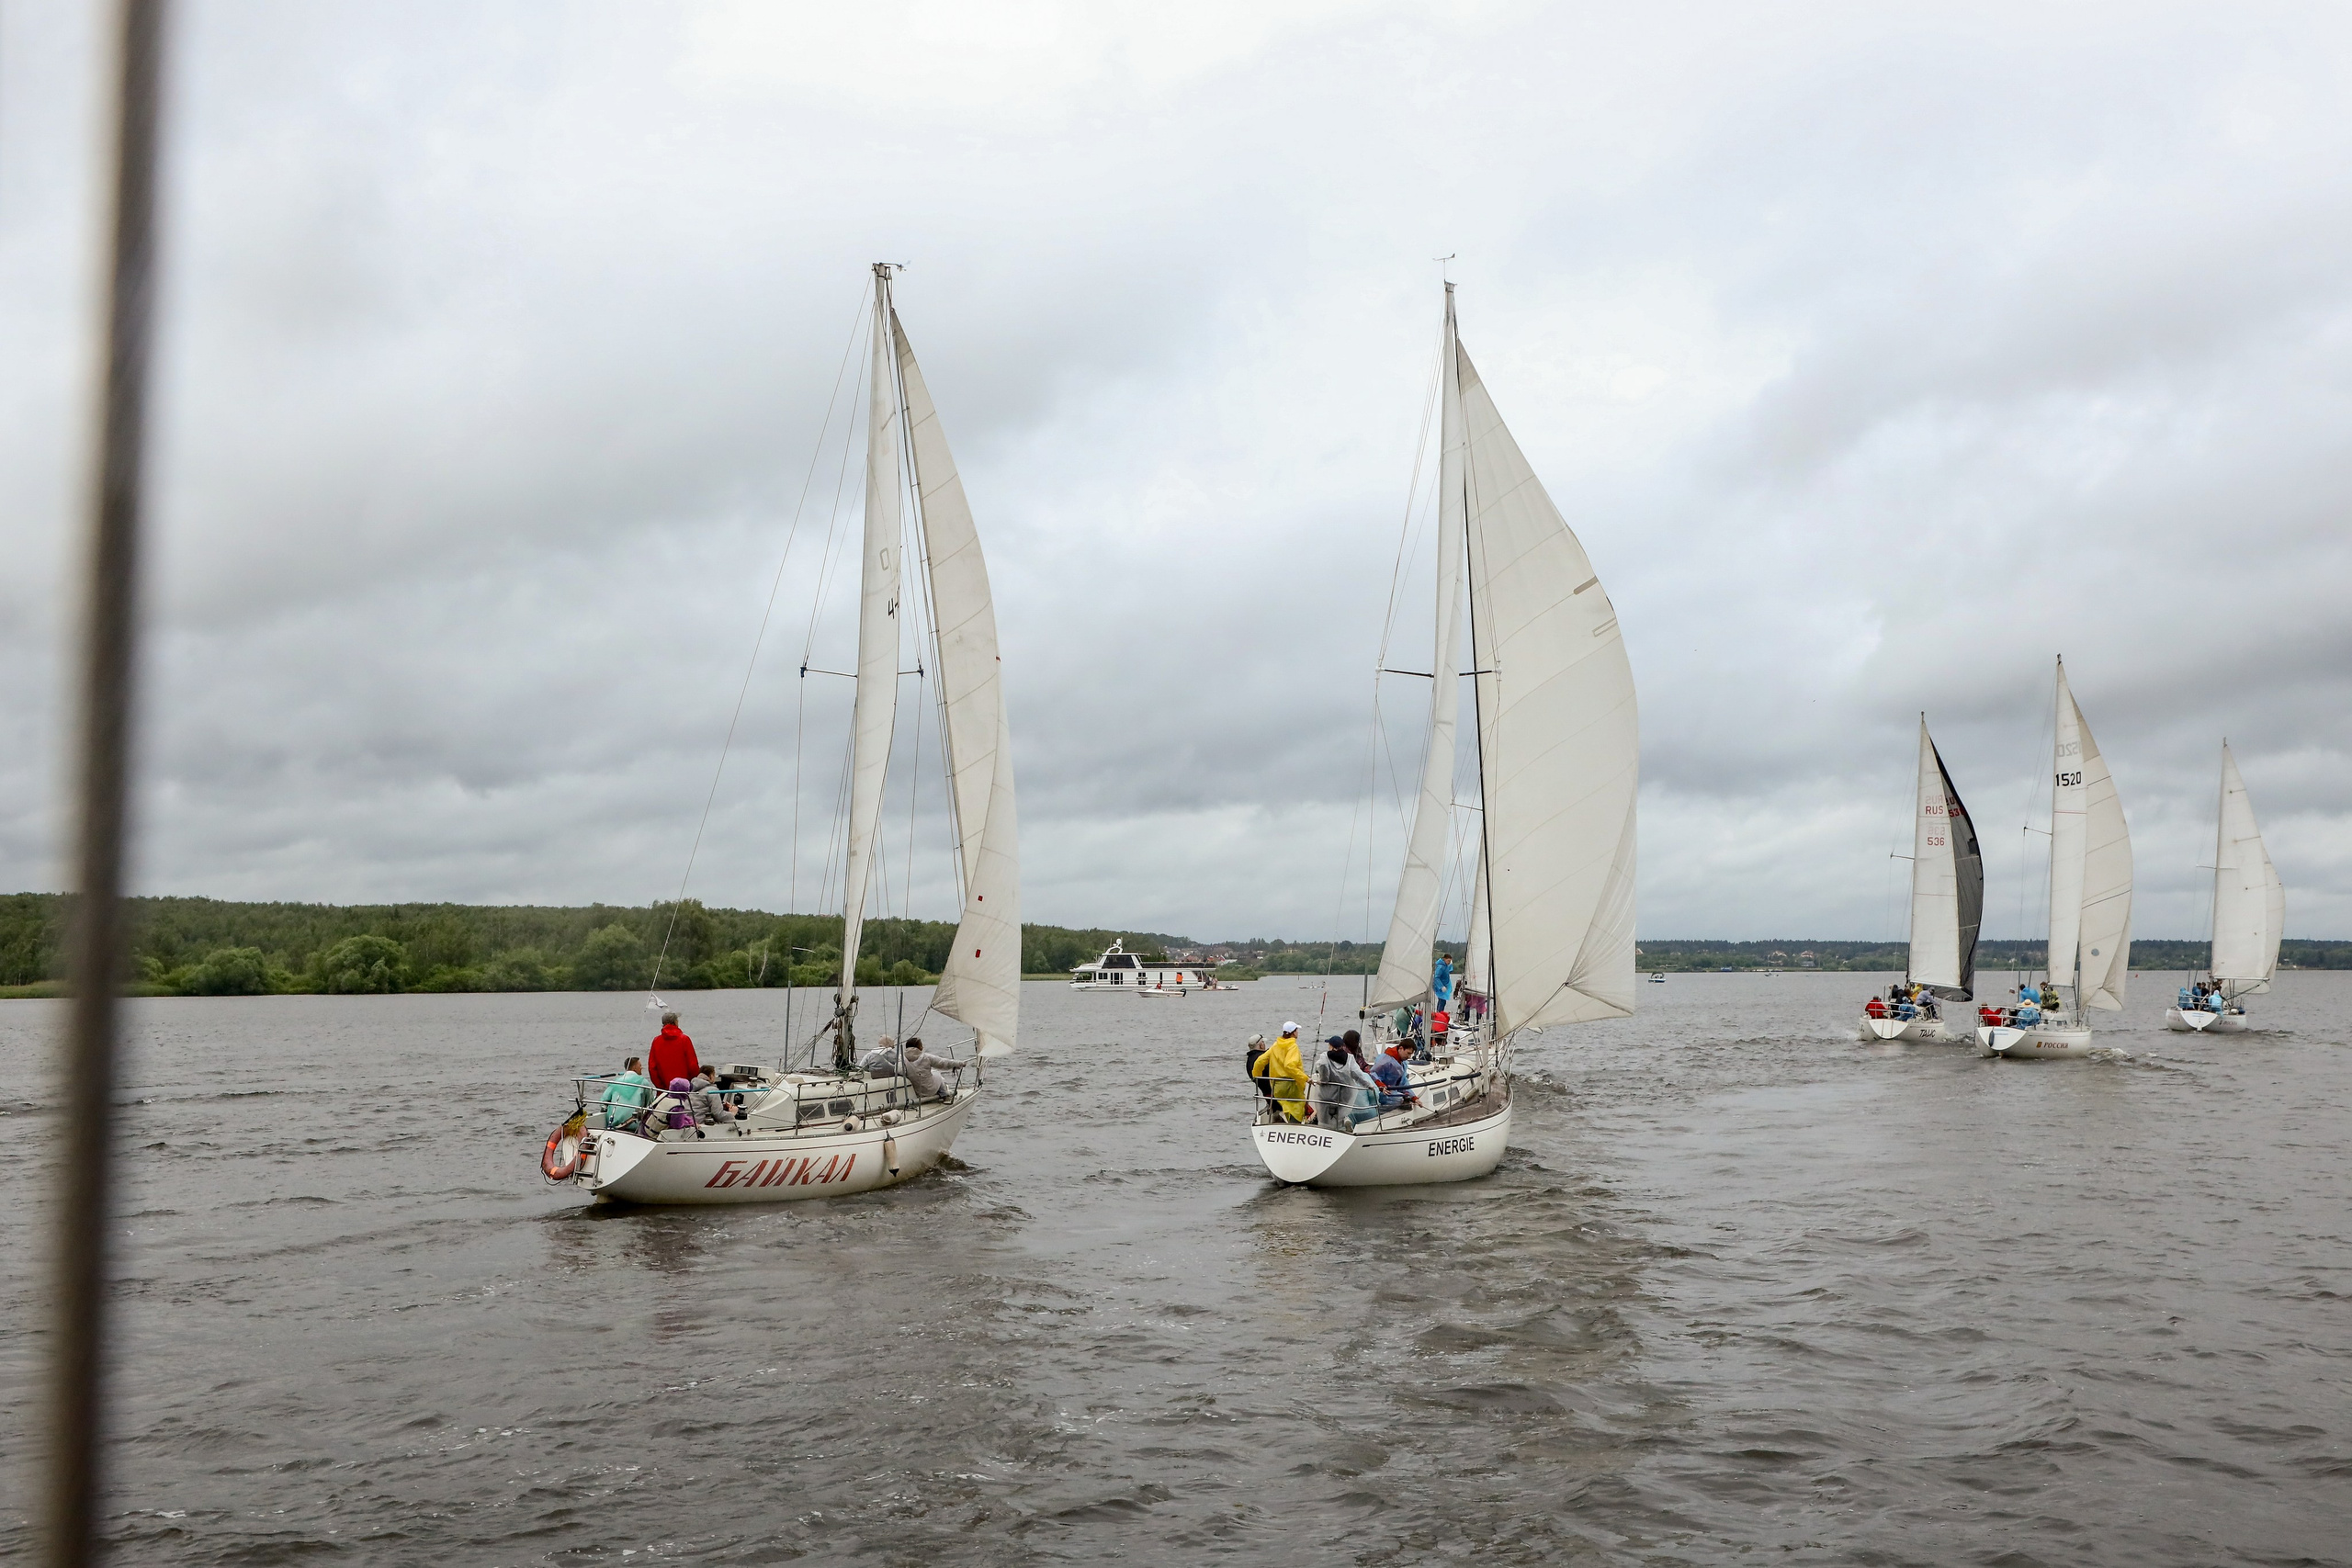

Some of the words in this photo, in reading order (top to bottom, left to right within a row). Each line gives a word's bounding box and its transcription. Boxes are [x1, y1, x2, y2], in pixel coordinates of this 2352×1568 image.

[2055, 772, 2081, 786] 1520
[1925, 806, 1943, 815] RUS
[1927, 837, 1944, 846] 536
[1267, 1131, 1333, 1148] ENERGIE
[1428, 1136, 1475, 1157] ENERGIE
[704, 1153, 857, 1188] БАЙКАЛ
